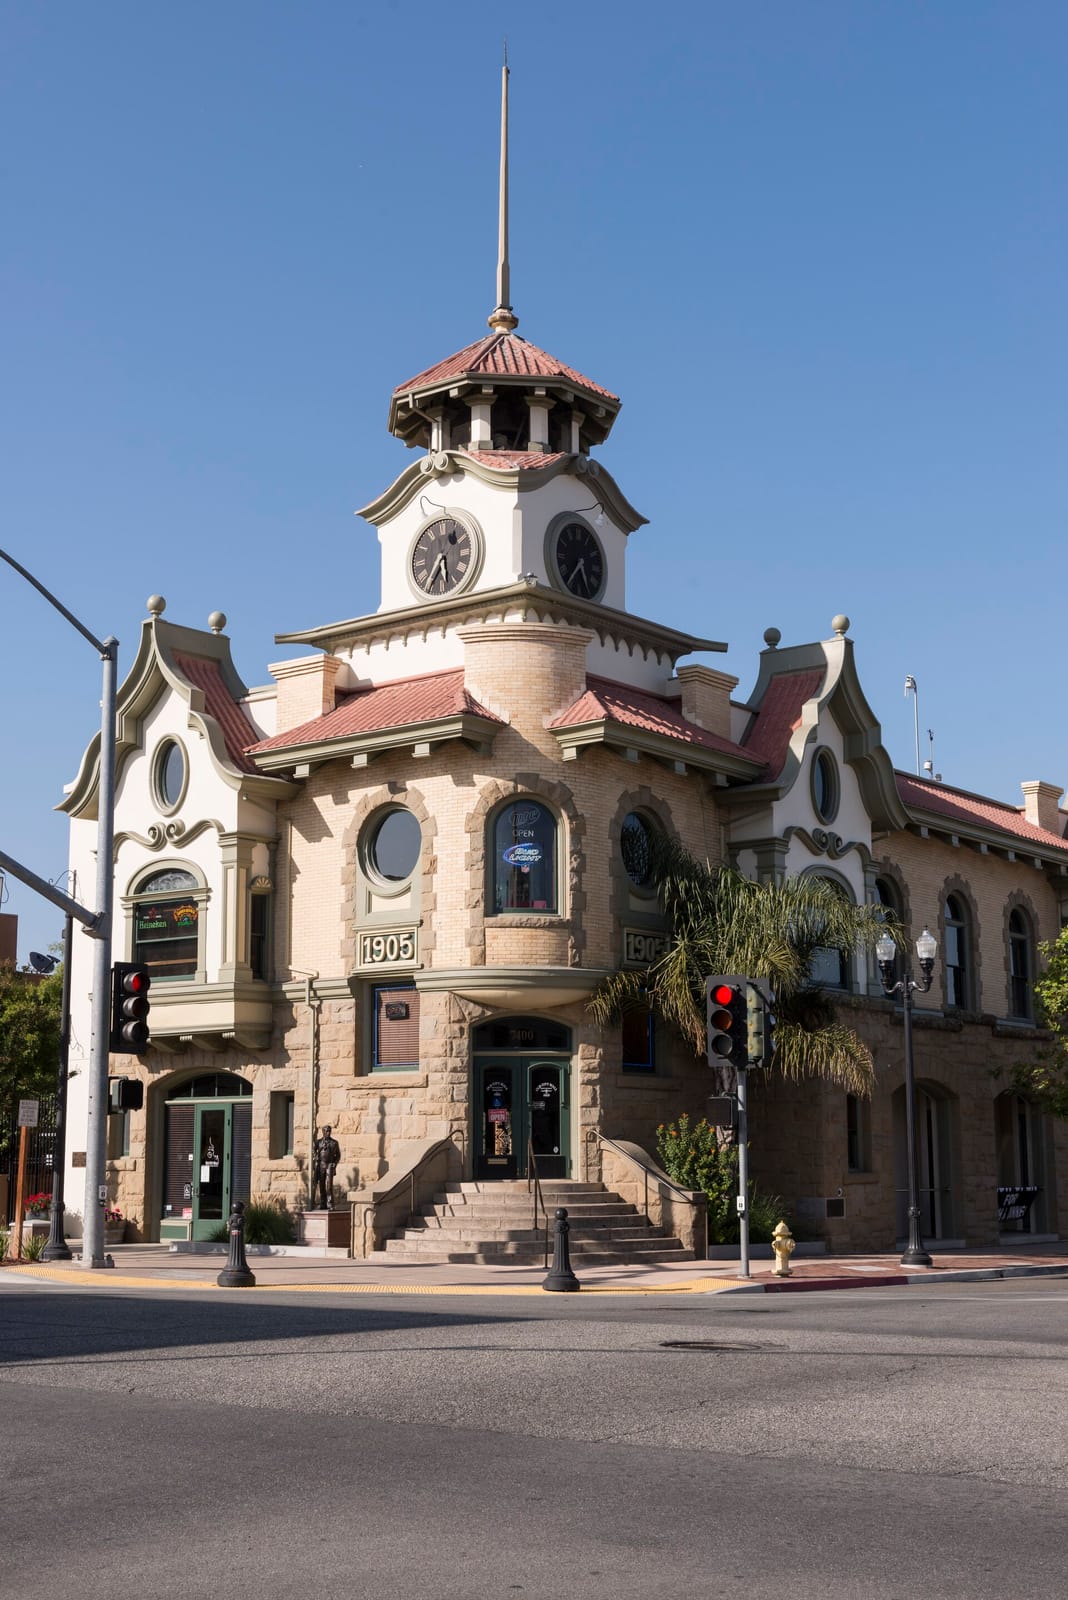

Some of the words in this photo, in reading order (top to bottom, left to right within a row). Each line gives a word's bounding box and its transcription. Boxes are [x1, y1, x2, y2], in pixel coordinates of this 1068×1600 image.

[512, 829, 534, 838] OPEN
[515, 847, 540, 856] BUD
[508, 853, 542, 862] LIGHT
[139, 920, 167, 929] Heineken
[363, 933, 414, 963] 1905
[490, 1113, 506, 1121] OPEN
